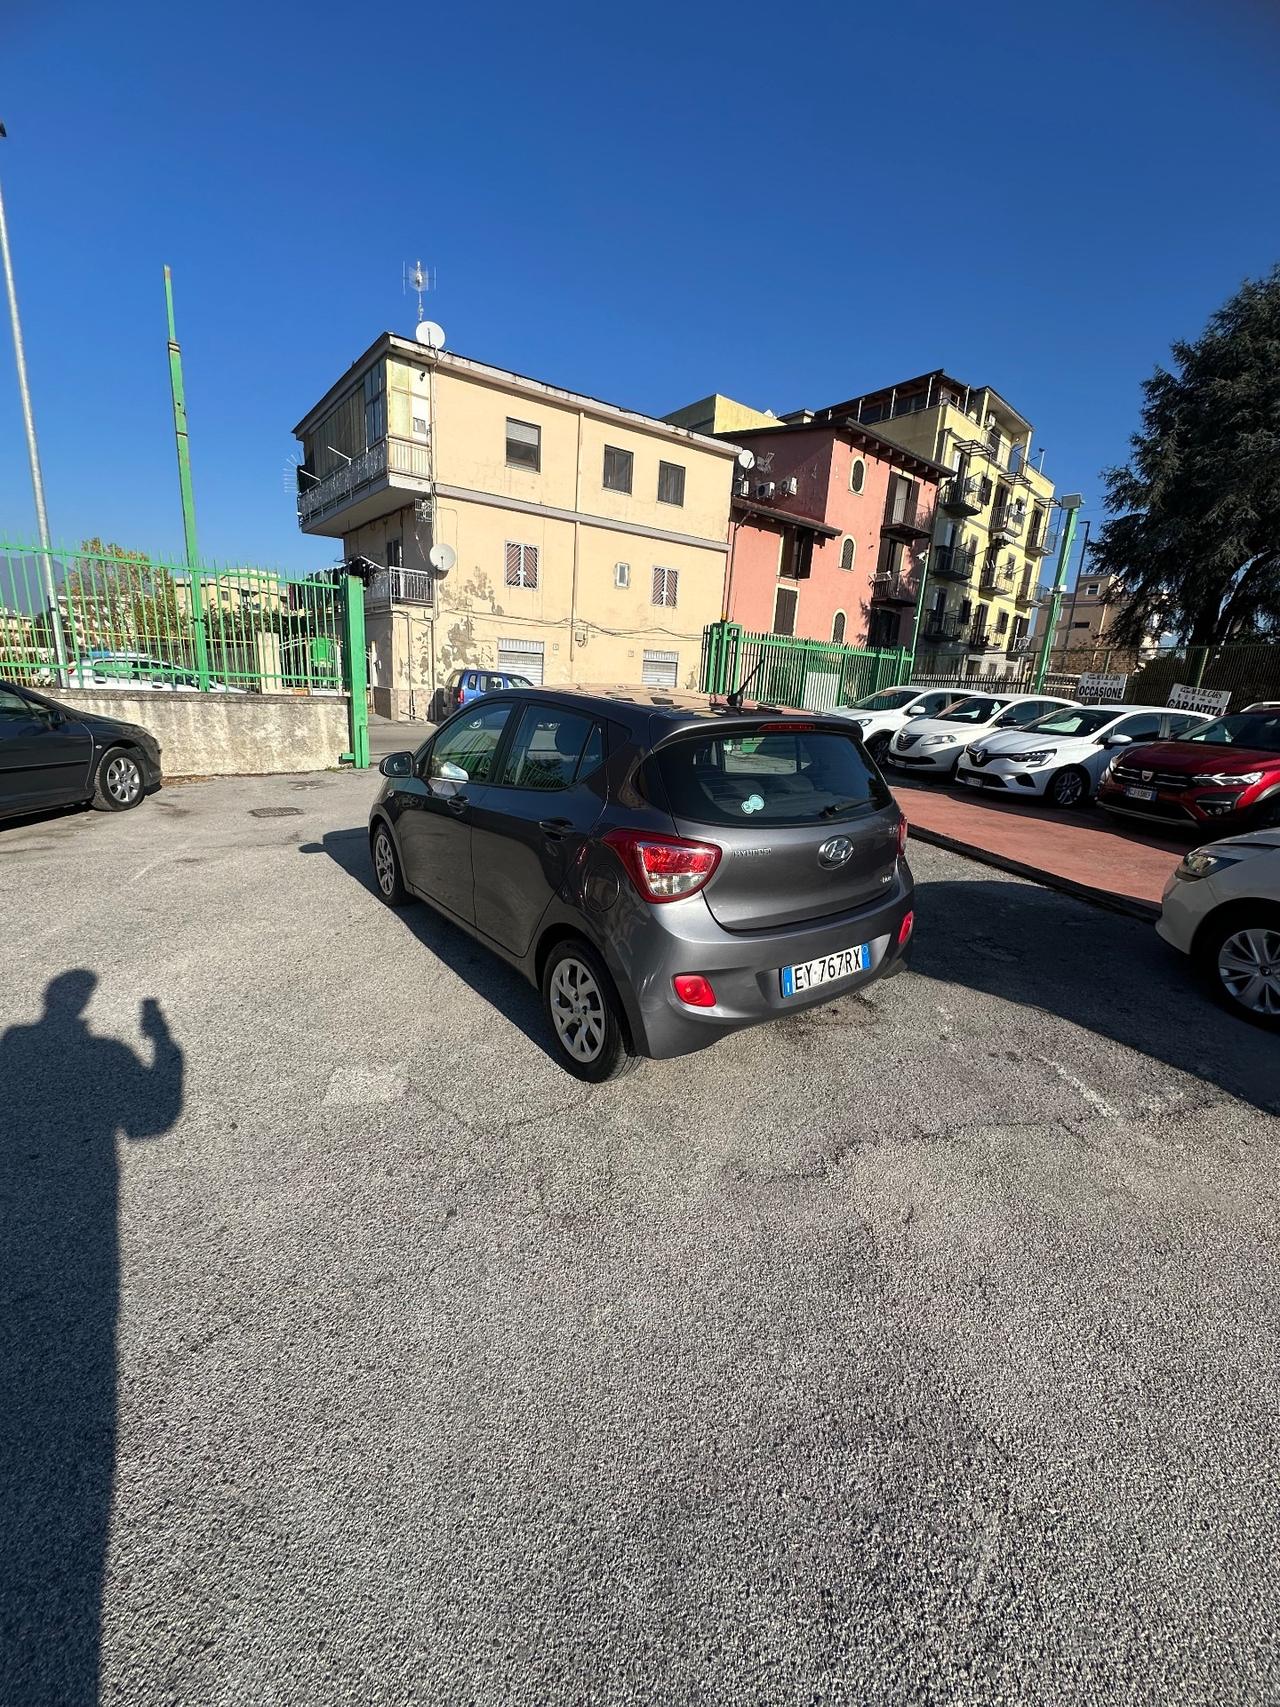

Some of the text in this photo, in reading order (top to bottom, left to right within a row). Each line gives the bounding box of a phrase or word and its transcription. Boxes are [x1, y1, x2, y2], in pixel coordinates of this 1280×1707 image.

[1078, 685, 1123, 699] OCCASIONE
[1167, 699, 1224, 717] GARANTITA
[794, 963, 813, 990] EY
[818, 947, 862, 983] 767RX
